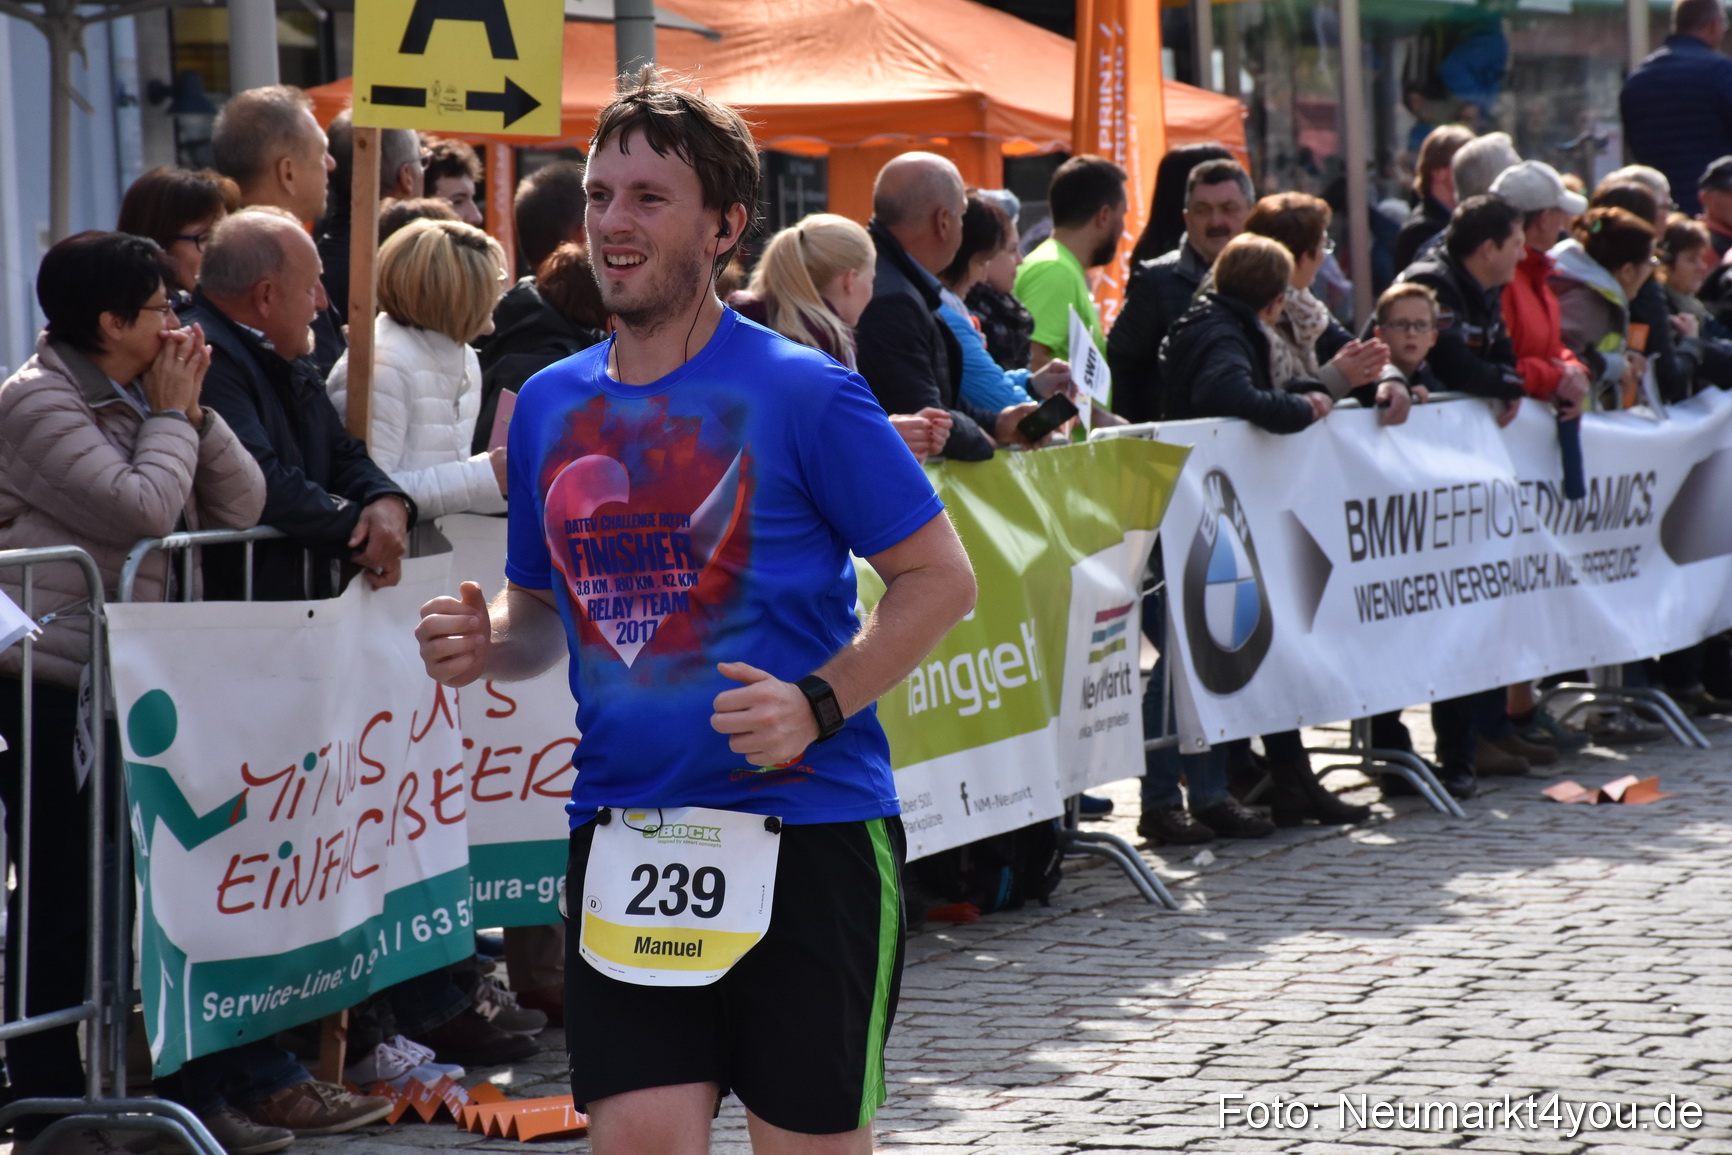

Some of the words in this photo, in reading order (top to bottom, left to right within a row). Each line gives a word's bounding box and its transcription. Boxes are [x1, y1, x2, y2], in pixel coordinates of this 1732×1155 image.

[398, 0, 519, 60] A
[1099, 48, 1113, 149] PRINT
[565, 518, 598, 535] DATEV
[601, 513, 657, 530] CHALLENGE
[659, 512, 692, 528] ROTH
[1344, 490, 1428, 563] BMW
[593, 579, 609, 595] KM
[614, 576, 634, 592] 180
[636, 575, 655, 590] KM
[662, 573, 677, 588] 42
[678, 571, 699, 587] KM
[1354, 572, 1442, 624] WENIGER
[588, 596, 634, 622] RELAY
[640, 591, 690, 618] TEAM
[616, 620, 659, 645] 2017
[658, 824, 722, 843] BOCK
[590, 899, 597, 909] D
[625, 863, 726, 919] 239
[633, 936, 703, 958] Manuel
[203, 965, 347, 1022] Service-Line:
